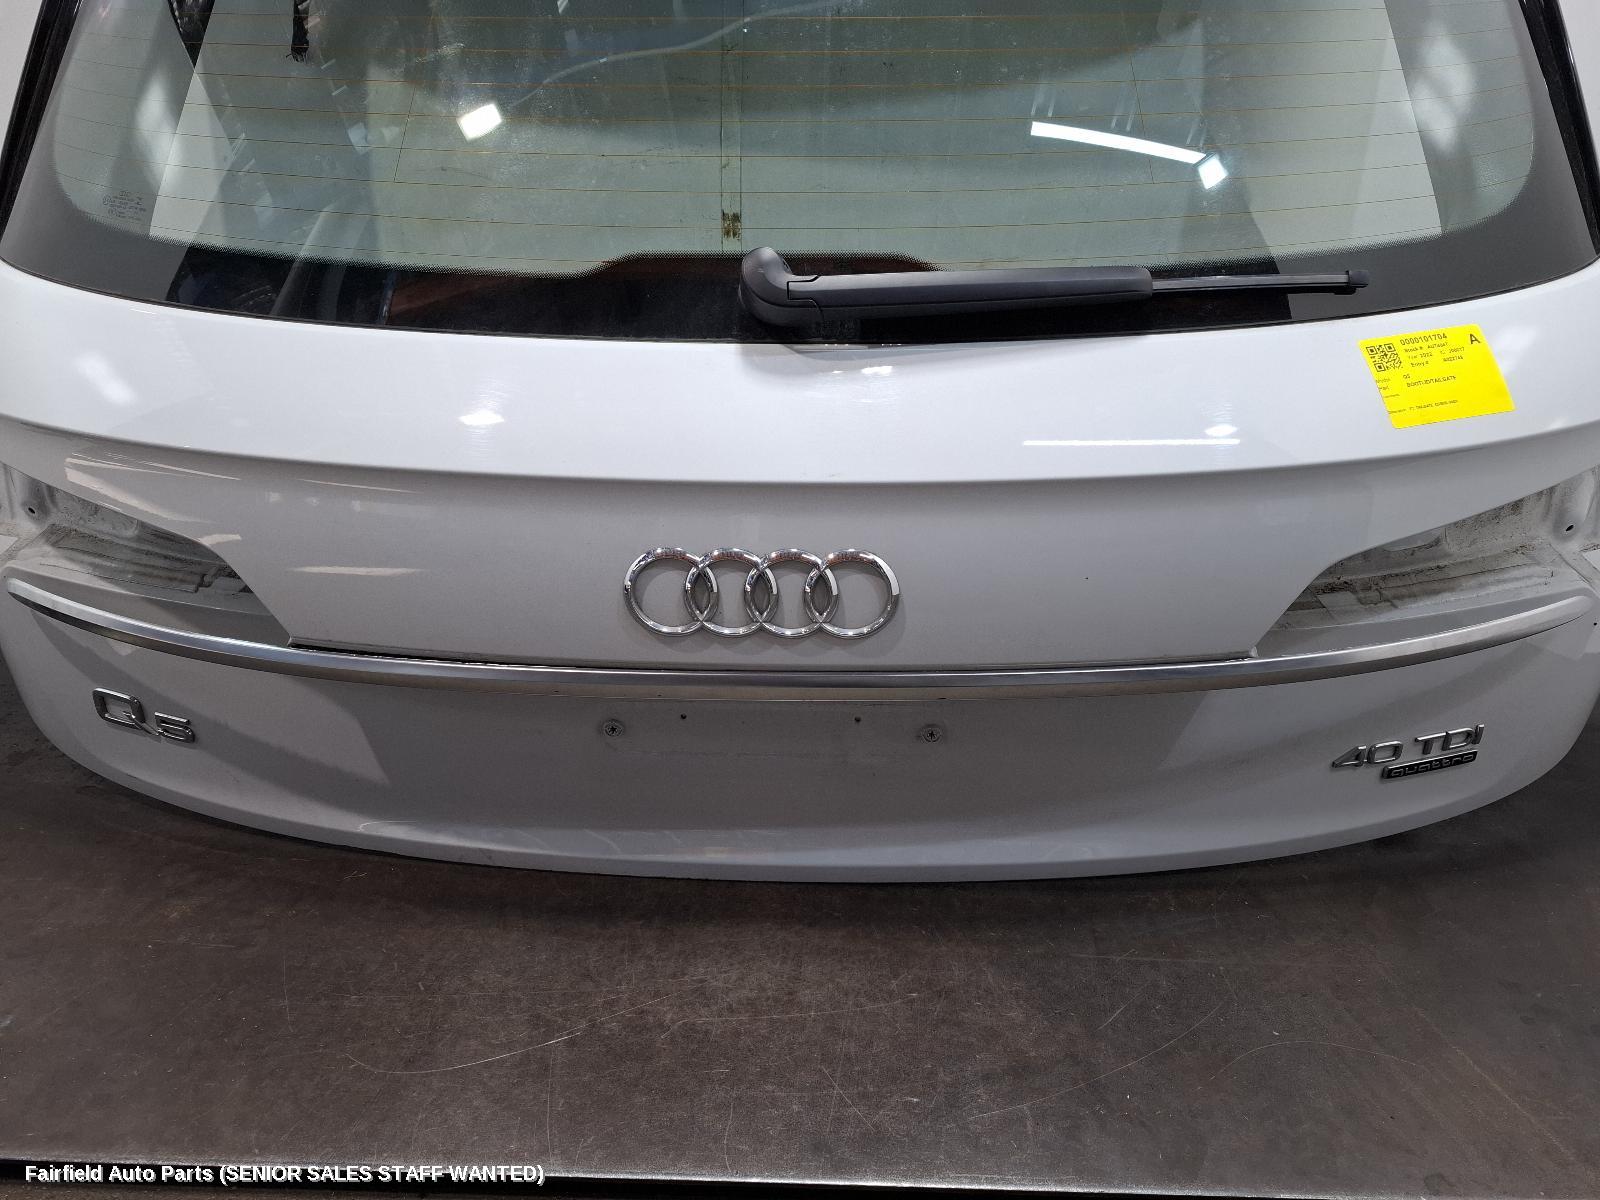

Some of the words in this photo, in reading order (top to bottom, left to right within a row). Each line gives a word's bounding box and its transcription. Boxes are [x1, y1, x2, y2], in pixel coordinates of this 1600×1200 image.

[1399, 333, 1447, 345] 0000101704
[1470, 333, 1480, 344] A
[92, 687, 196, 743] Q5
[1331, 740, 1404, 769] 40
[1415, 723, 1485, 755] TDI
[1387, 752, 1476, 778] quattro
